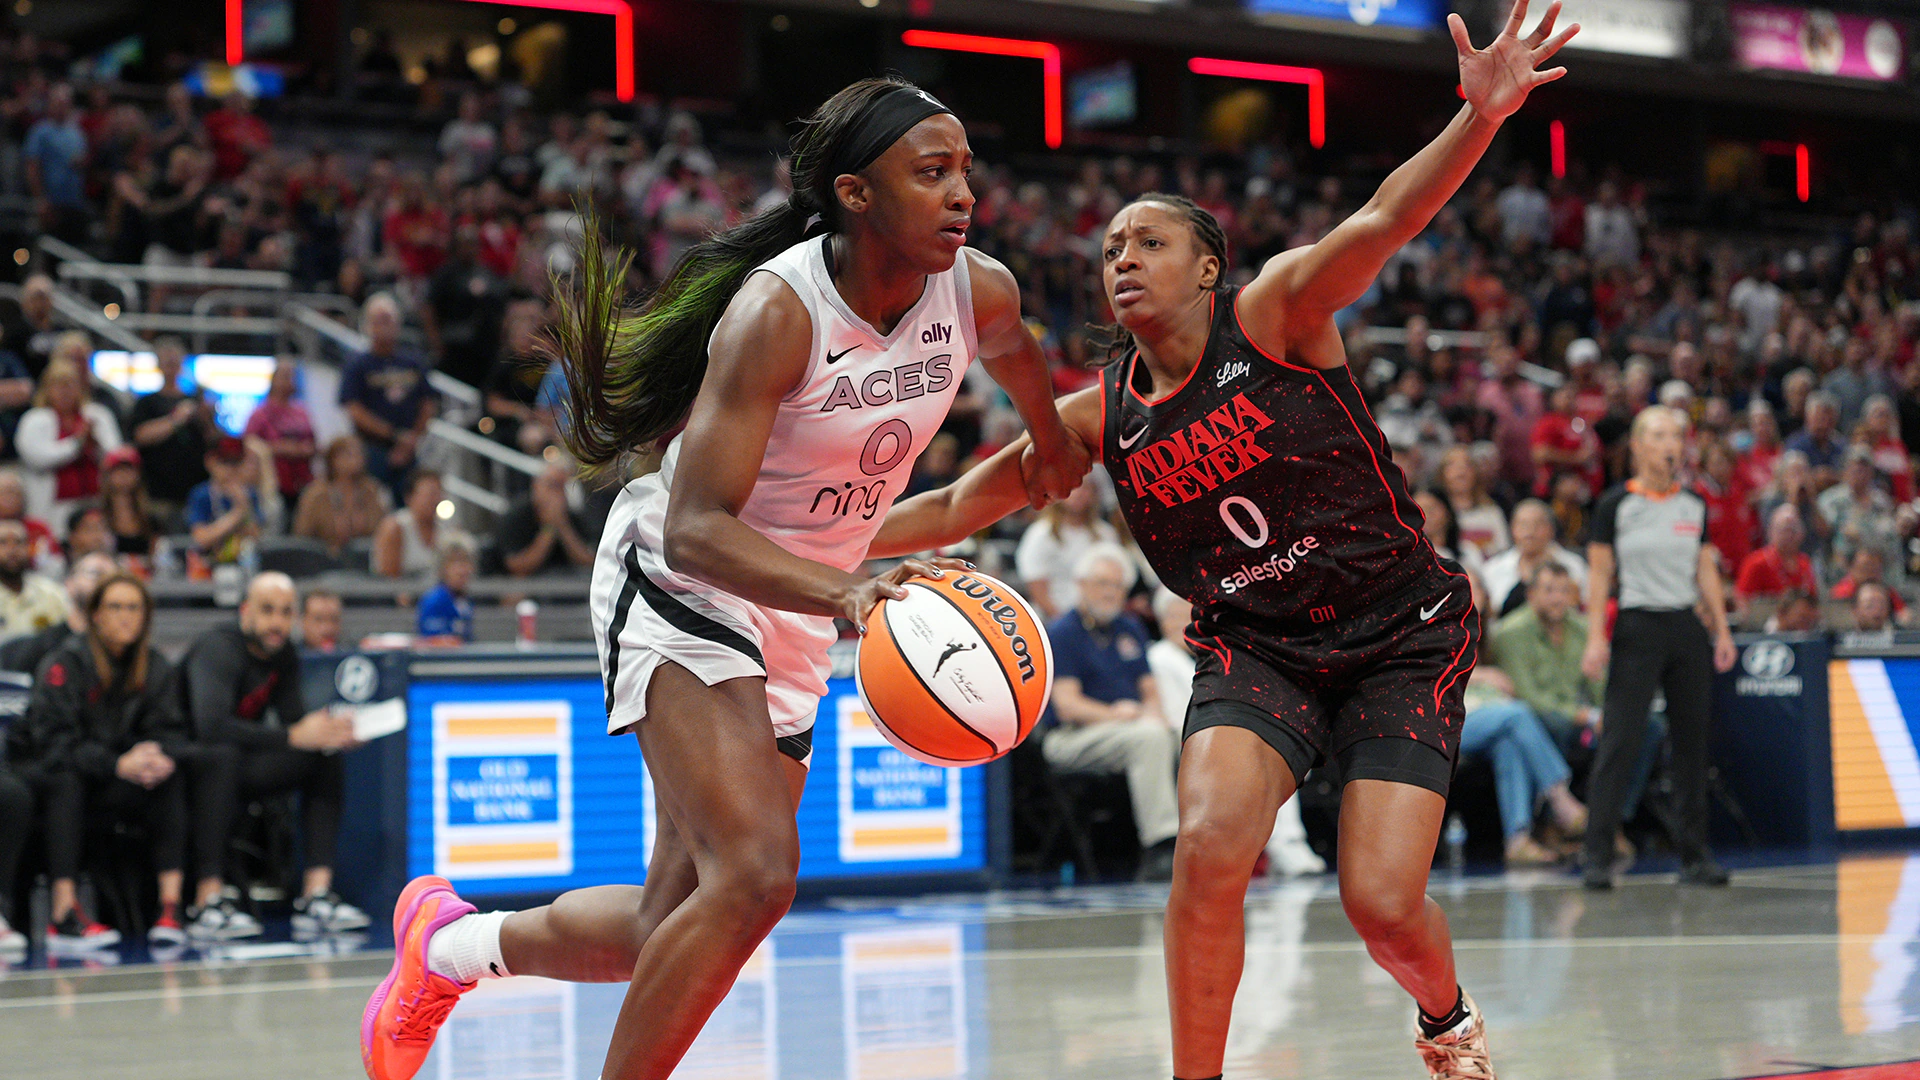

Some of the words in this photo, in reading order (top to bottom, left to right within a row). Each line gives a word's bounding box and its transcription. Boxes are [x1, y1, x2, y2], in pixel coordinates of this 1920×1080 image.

[921, 322, 953, 345] ally
[820, 354, 953, 412] ACES
[1215, 361, 1251, 389] Lilly
[859, 419, 912, 476] 0
[1124, 392, 1276, 498] INDIANA
[1145, 430, 1273, 508] FEVER
[809, 479, 887, 521] ring
[1218, 495, 1270, 549] 0
[1220, 533, 1322, 594] salesforce
[951, 574, 1036, 685] Wilson
[1736, 675, 1803, 697] HYUNDAI
[479, 759, 529, 781] OLD
[855, 767, 943, 789] NATIONAL
[451, 777, 553, 801] NATIONAL
[872, 787, 928, 808] BANK
[474, 800, 533, 822] BANK
